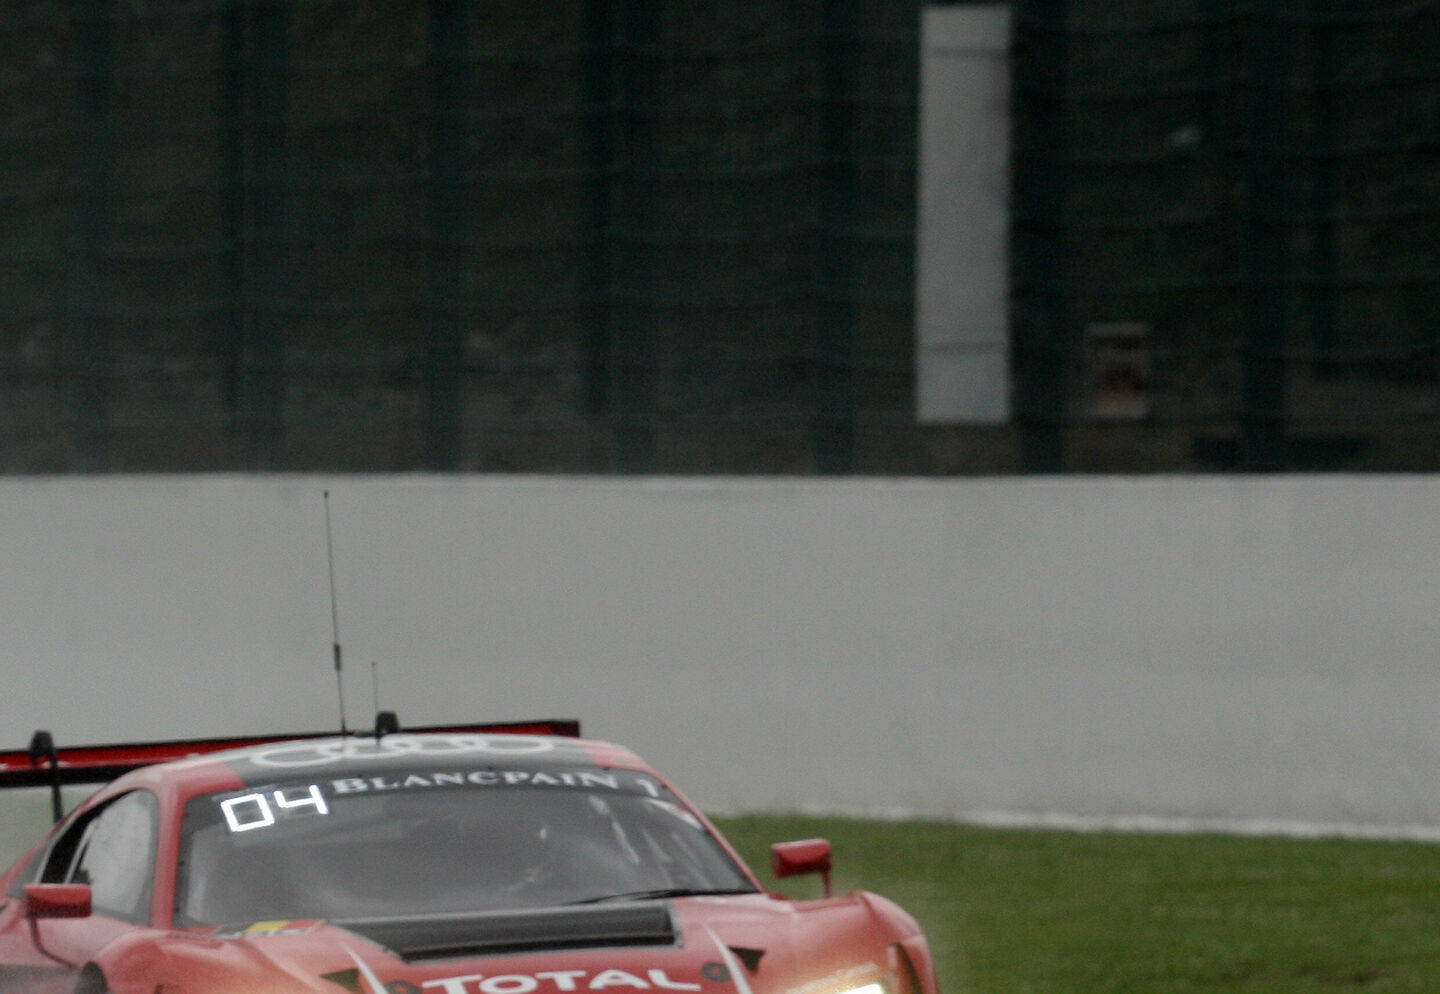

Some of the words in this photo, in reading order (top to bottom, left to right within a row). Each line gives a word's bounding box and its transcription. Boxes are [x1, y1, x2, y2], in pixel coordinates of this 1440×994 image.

[331, 770, 620, 795] BLANCPAIN
[635, 777, 659, 798] 1
[221, 784, 329, 833] 04
